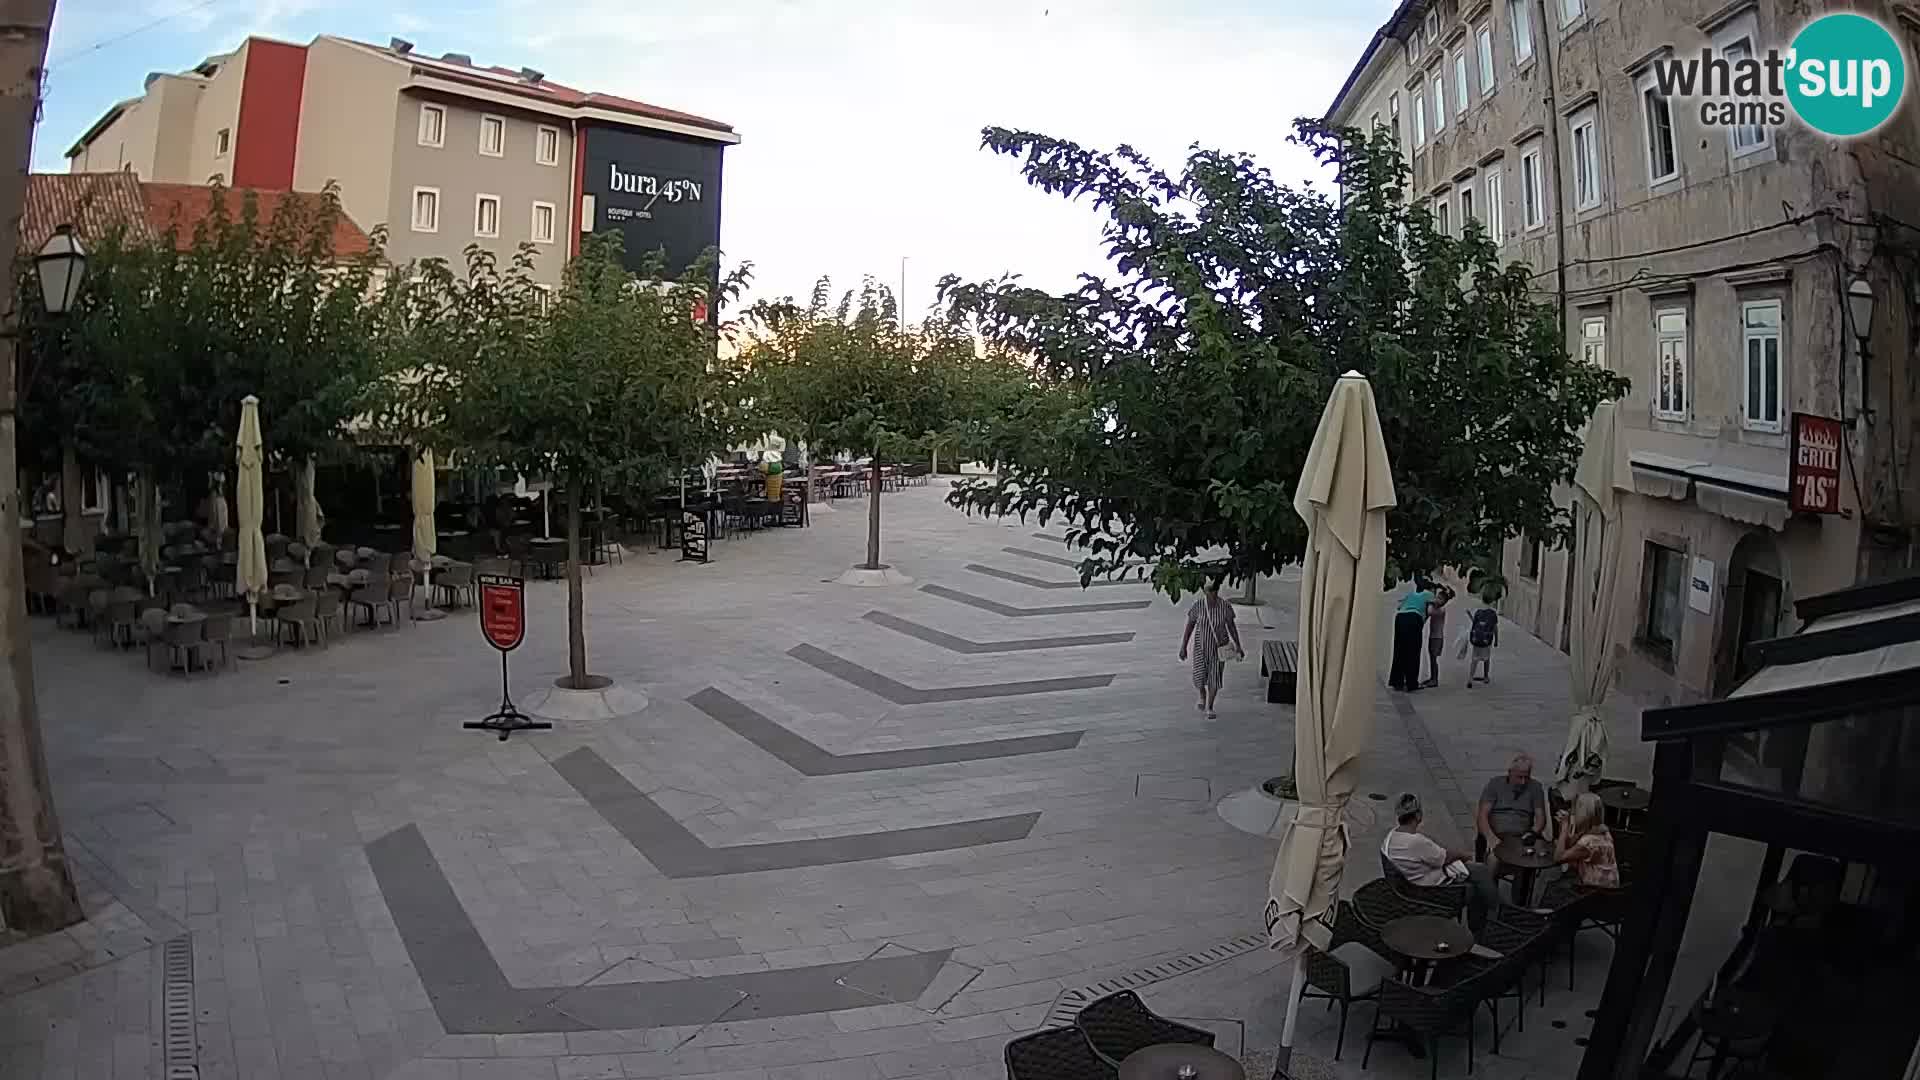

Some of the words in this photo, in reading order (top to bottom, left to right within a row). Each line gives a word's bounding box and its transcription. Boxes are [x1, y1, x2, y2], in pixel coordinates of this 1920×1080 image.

[610, 164, 657, 195] bura
[608, 208, 632, 216] BOUTIQUE
[636, 211, 652, 219] HOTEL
[1798, 447, 1837, 469] GRILL
